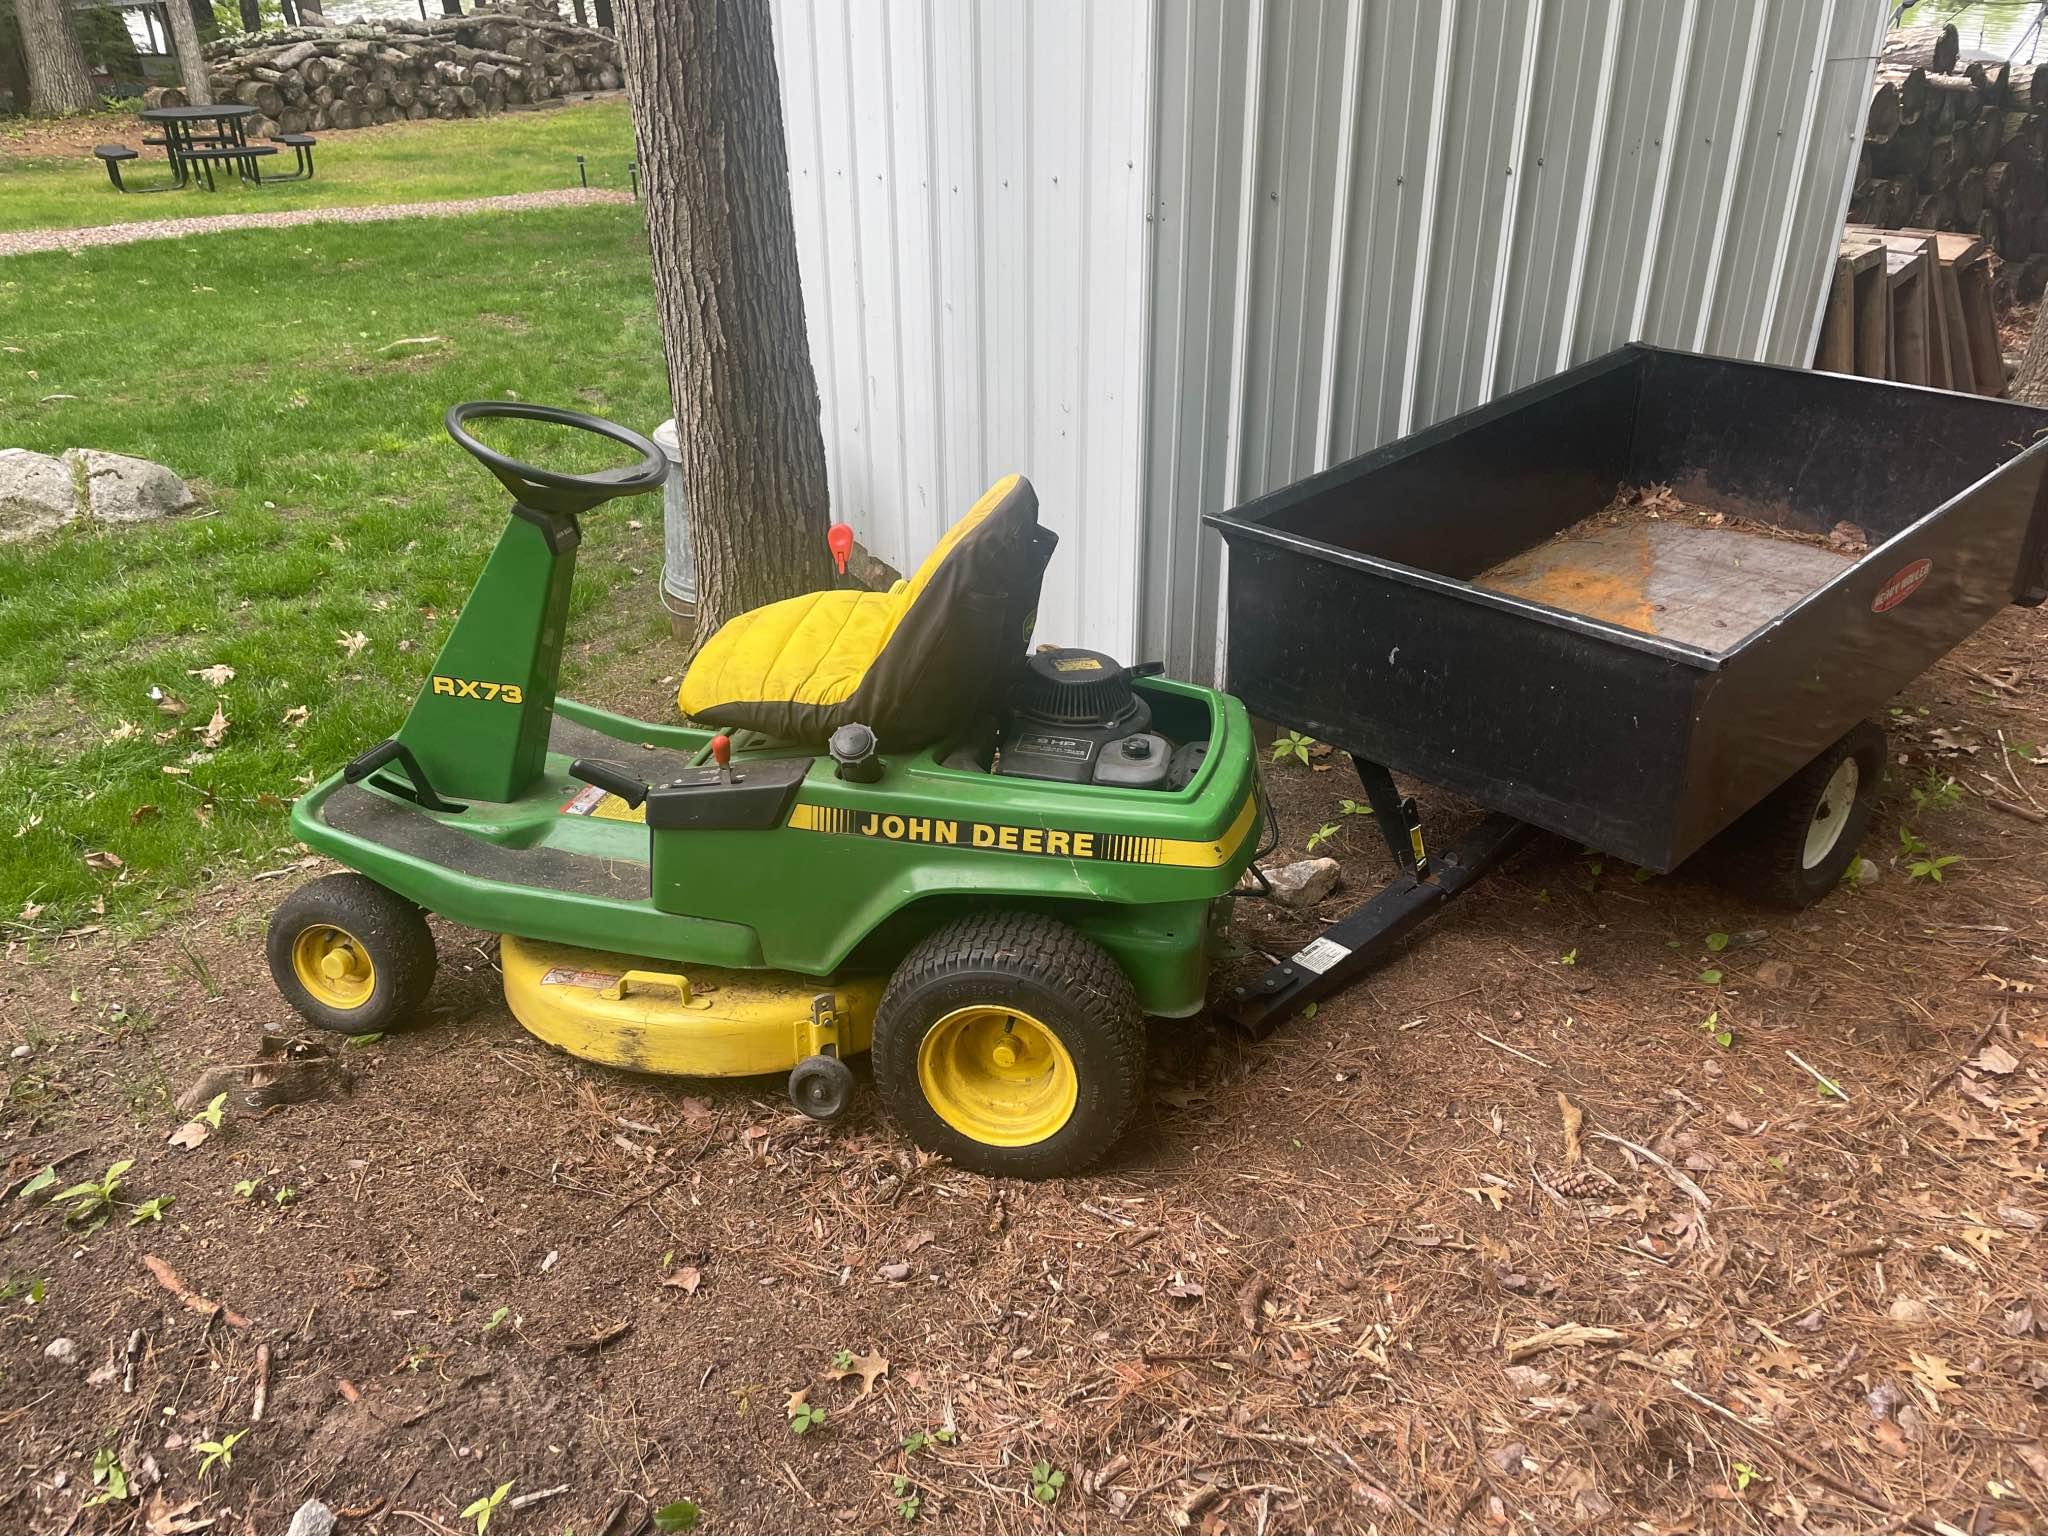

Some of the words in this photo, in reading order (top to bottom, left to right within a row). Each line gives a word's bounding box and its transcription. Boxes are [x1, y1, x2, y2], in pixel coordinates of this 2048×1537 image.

[433, 675, 522, 703] RX73
[861, 814, 957, 844] JOHN
[972, 824, 1093, 856] DEERE
